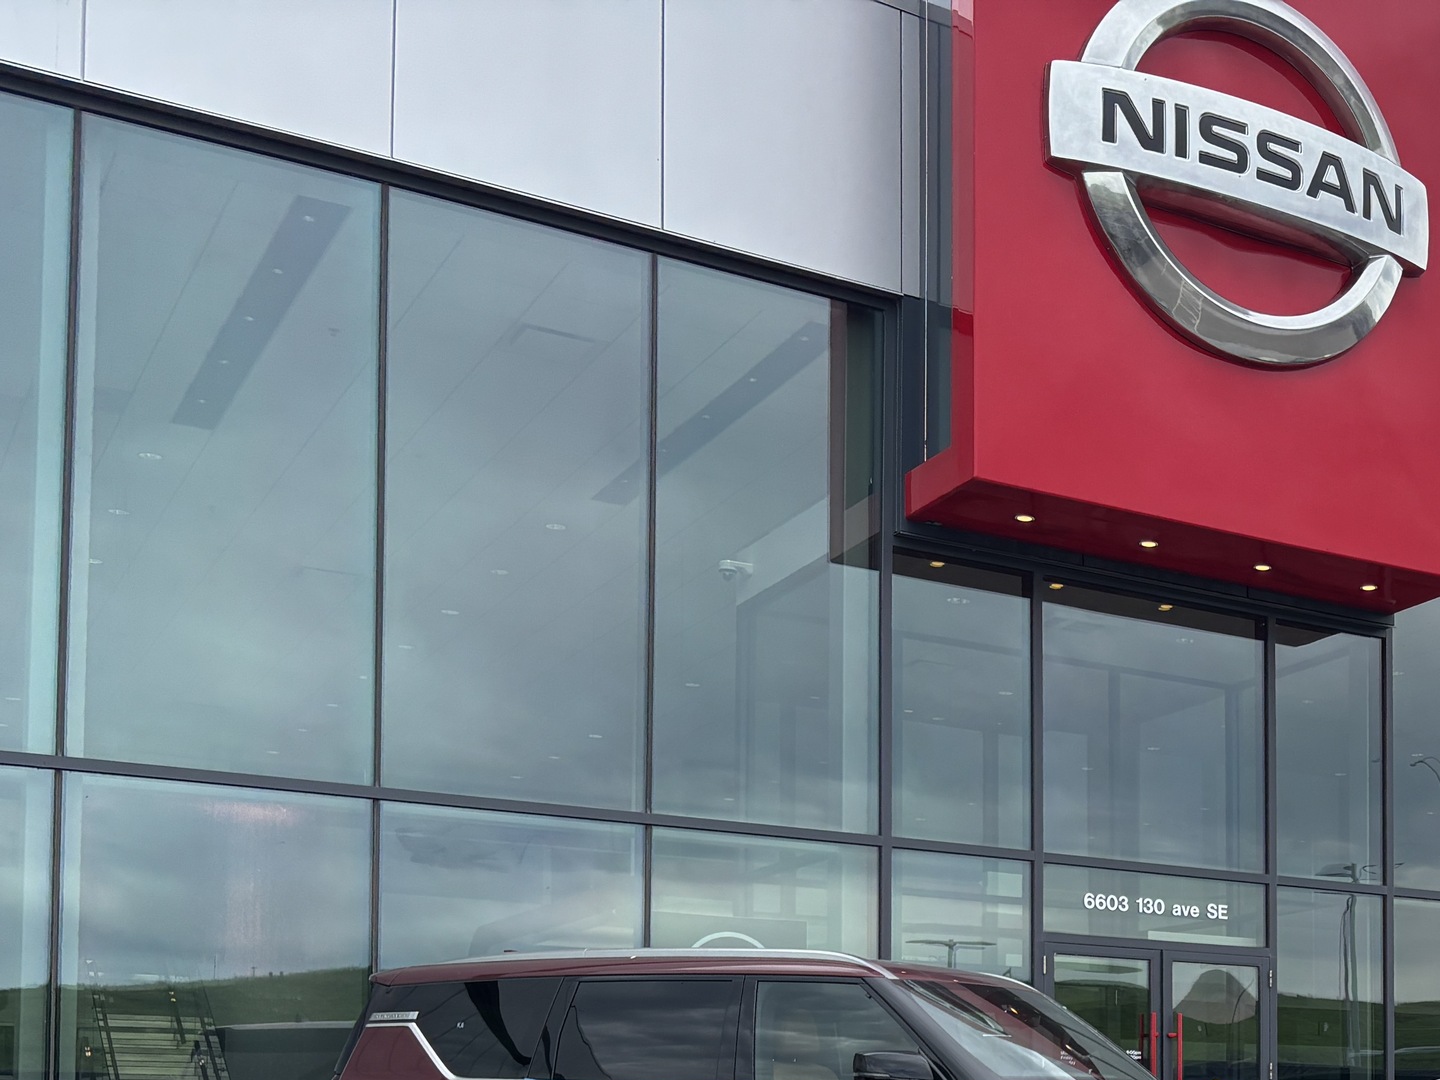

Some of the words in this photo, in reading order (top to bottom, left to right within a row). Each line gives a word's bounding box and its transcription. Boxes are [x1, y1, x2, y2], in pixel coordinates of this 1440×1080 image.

[1101, 88, 1404, 236] NISSAN
[1083, 892, 1129, 912] 6603
[1135, 897, 1165, 915] 130
[1172, 904, 1200, 918] ave
[1206, 903, 1229, 920] SE
